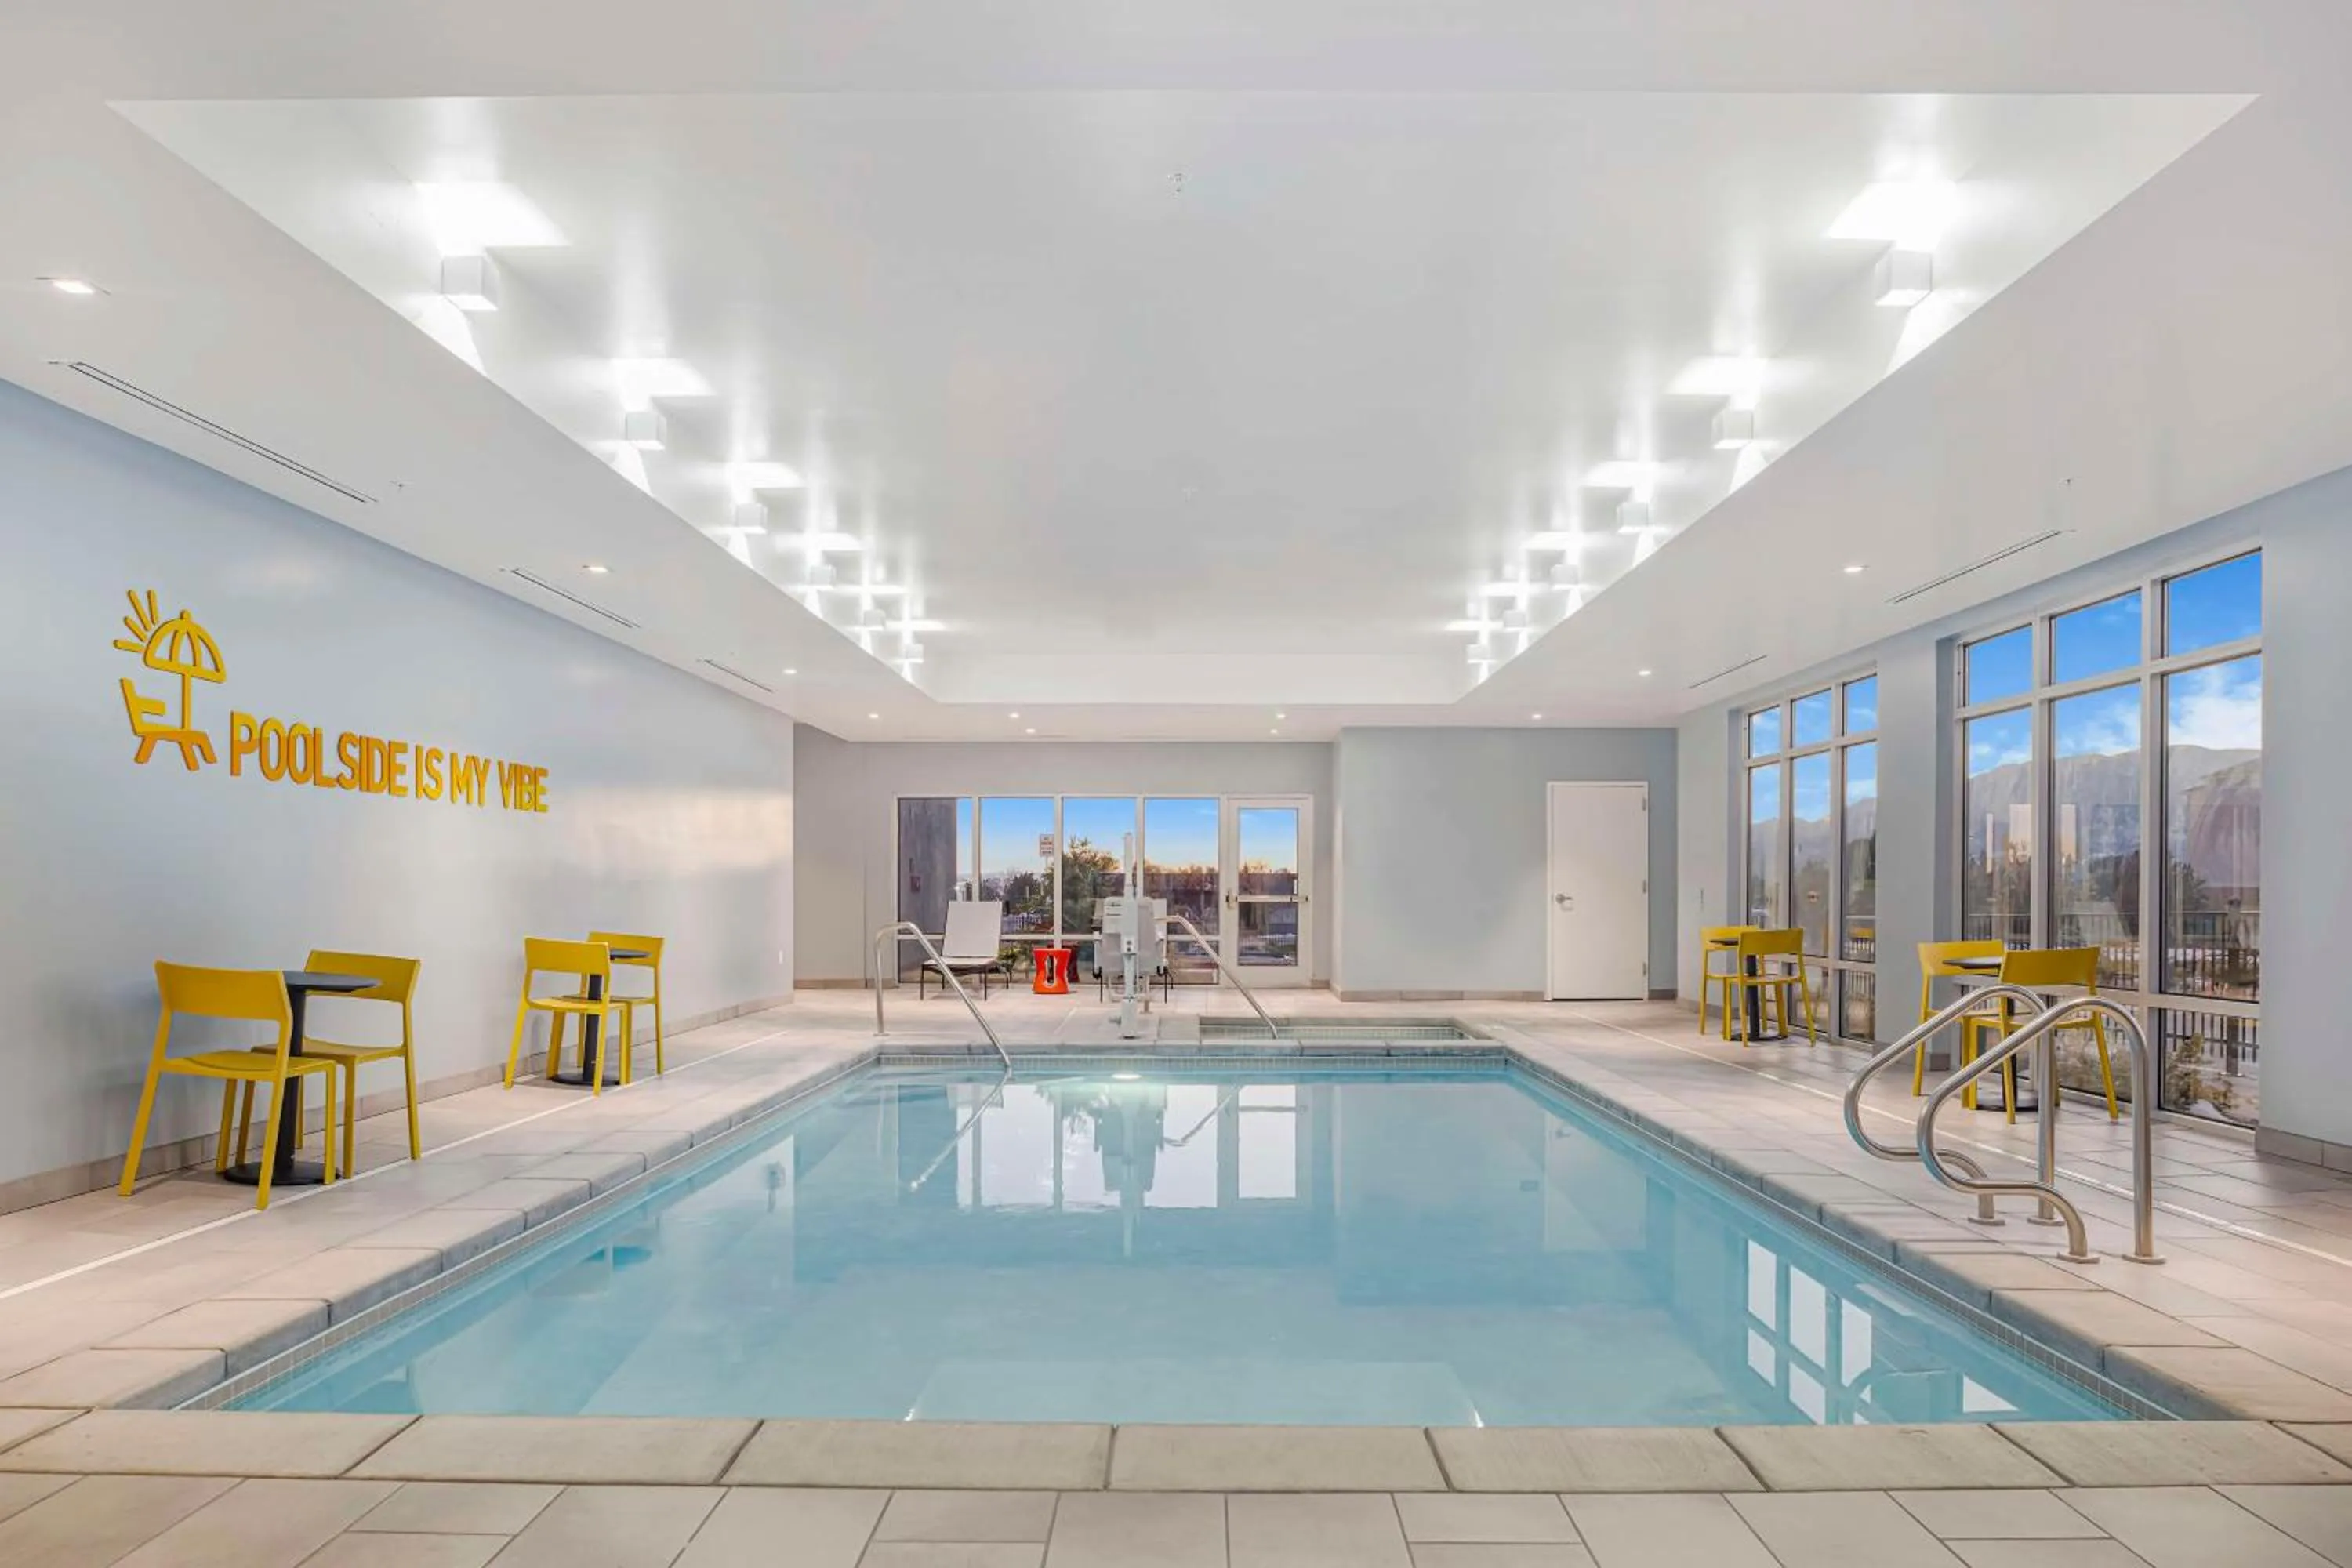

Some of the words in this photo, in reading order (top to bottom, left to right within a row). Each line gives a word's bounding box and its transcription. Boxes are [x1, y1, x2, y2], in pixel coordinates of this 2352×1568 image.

[230, 710, 408, 797] POOLSIDE
[415, 746, 445, 800] IS
[450, 753, 490, 807] MY
[497, 760, 549, 813] VIBE
